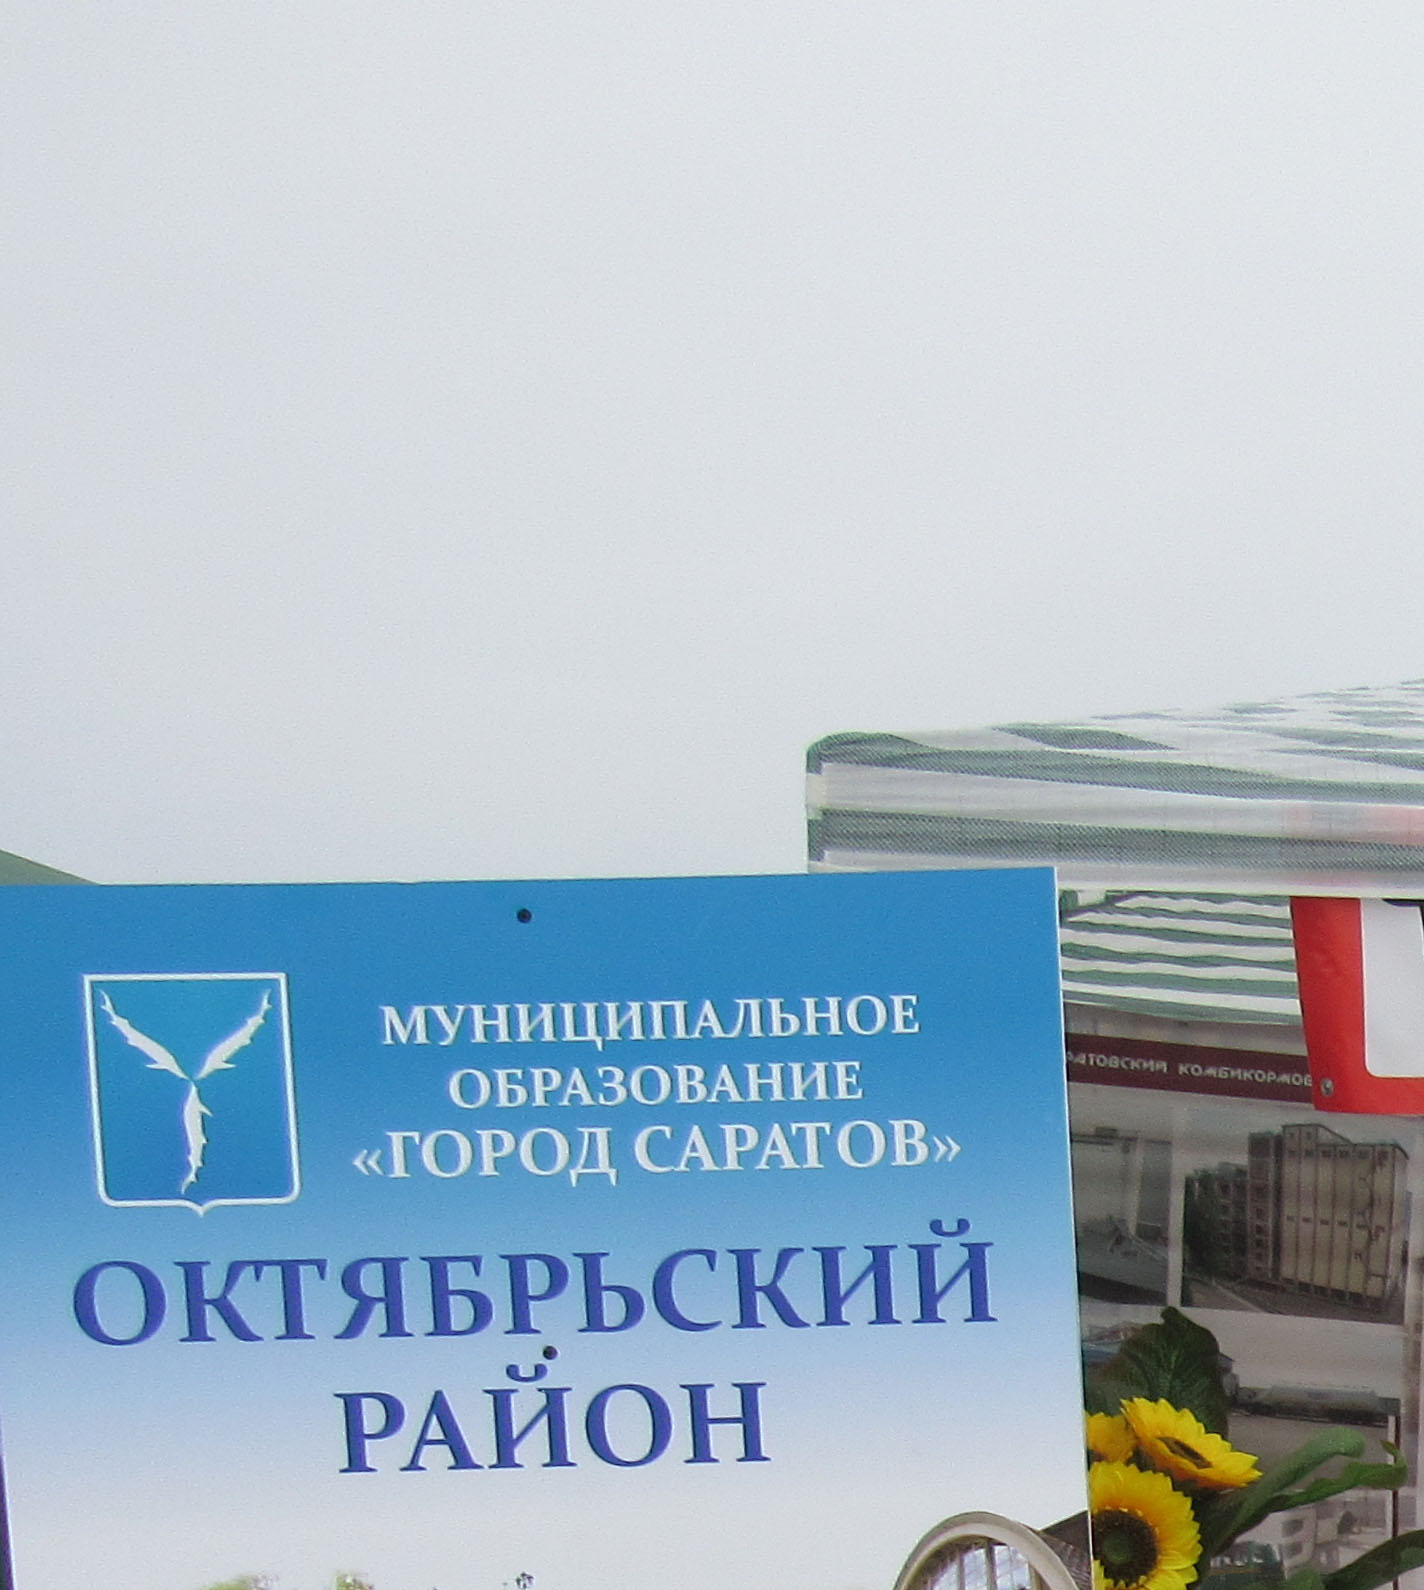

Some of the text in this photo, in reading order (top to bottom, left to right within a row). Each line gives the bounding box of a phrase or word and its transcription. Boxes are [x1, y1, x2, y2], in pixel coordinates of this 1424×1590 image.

[381, 995, 920, 1050] МУНИЦИПАЛЬНОЕ
[448, 1061, 863, 1109] ОБРАЗОВАНИЕ
[352, 1119, 961, 1186] «ГОРОД САРАТОВ»
[73, 1217, 998, 1346] ОКТЯБРЬСКИЙ
[335, 1363, 771, 1474] РАЙОН
